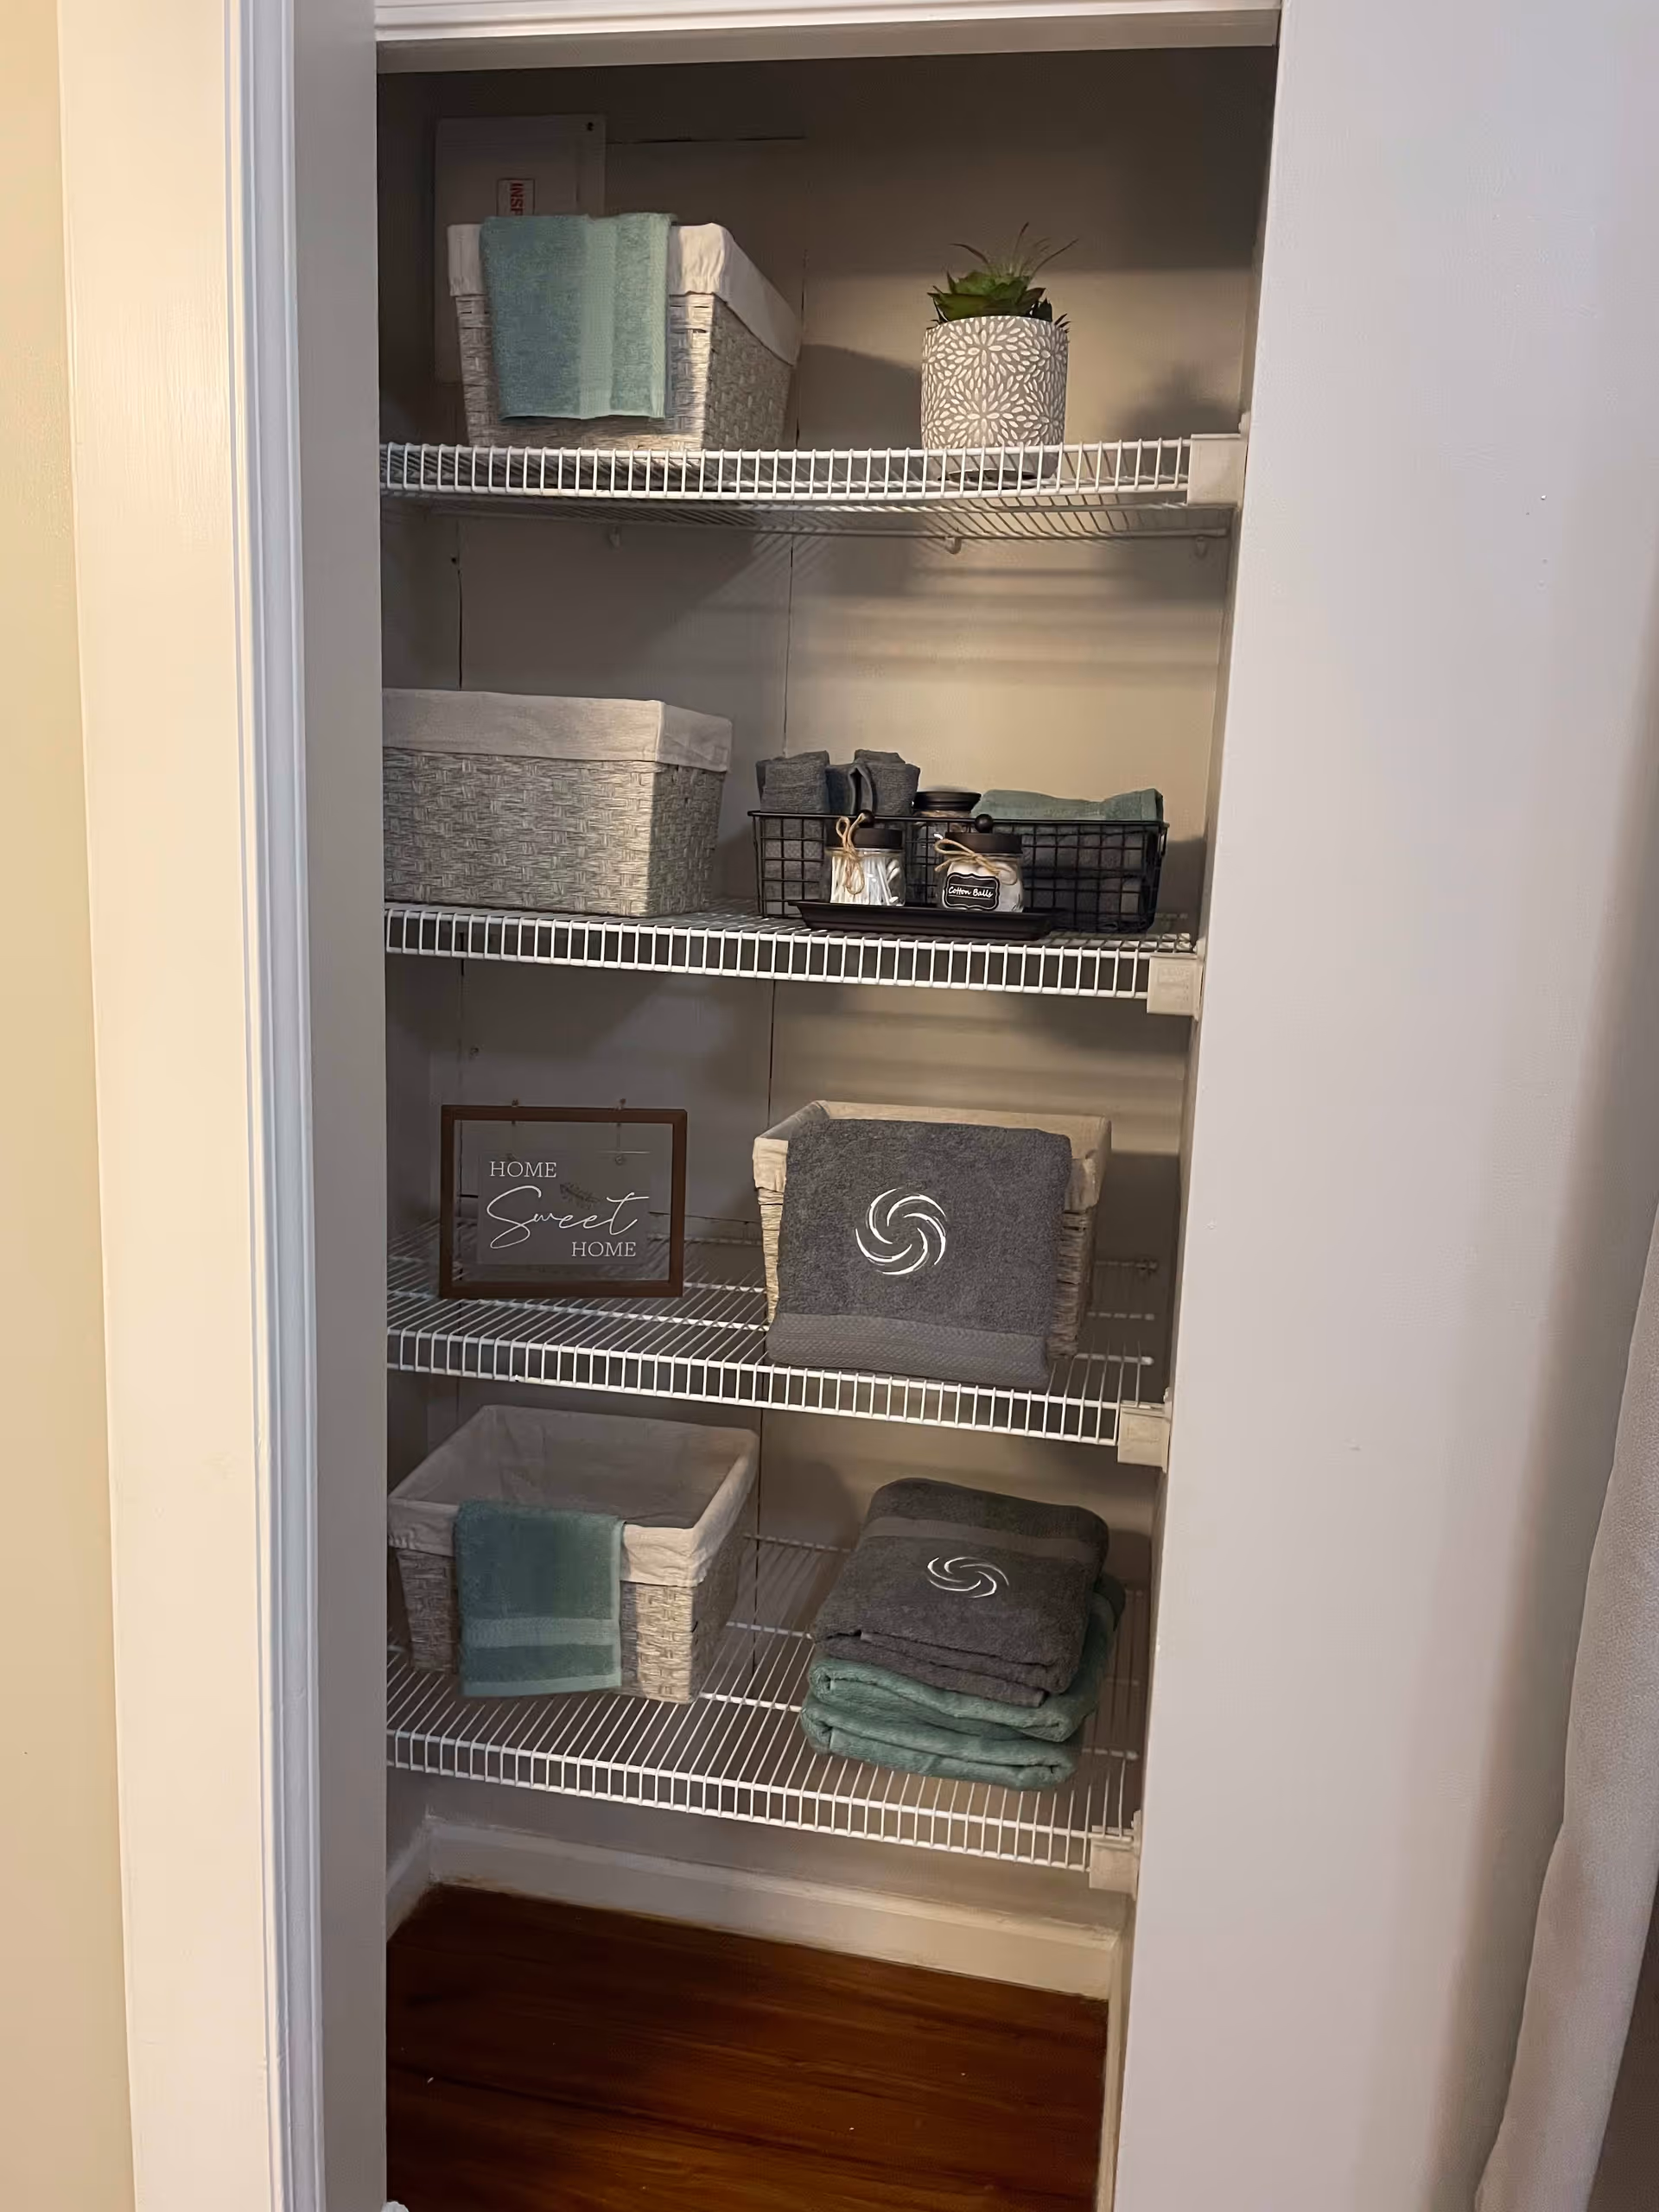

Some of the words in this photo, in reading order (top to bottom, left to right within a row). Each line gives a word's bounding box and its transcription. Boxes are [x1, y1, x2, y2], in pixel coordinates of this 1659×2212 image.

[948, 886, 971, 895] Cotton
[972, 888, 994, 897] Balls
[490, 1161, 557, 1179] HOME
[486, 1185, 650, 1249] Sweet
[571, 1242, 637, 1258] HOME
